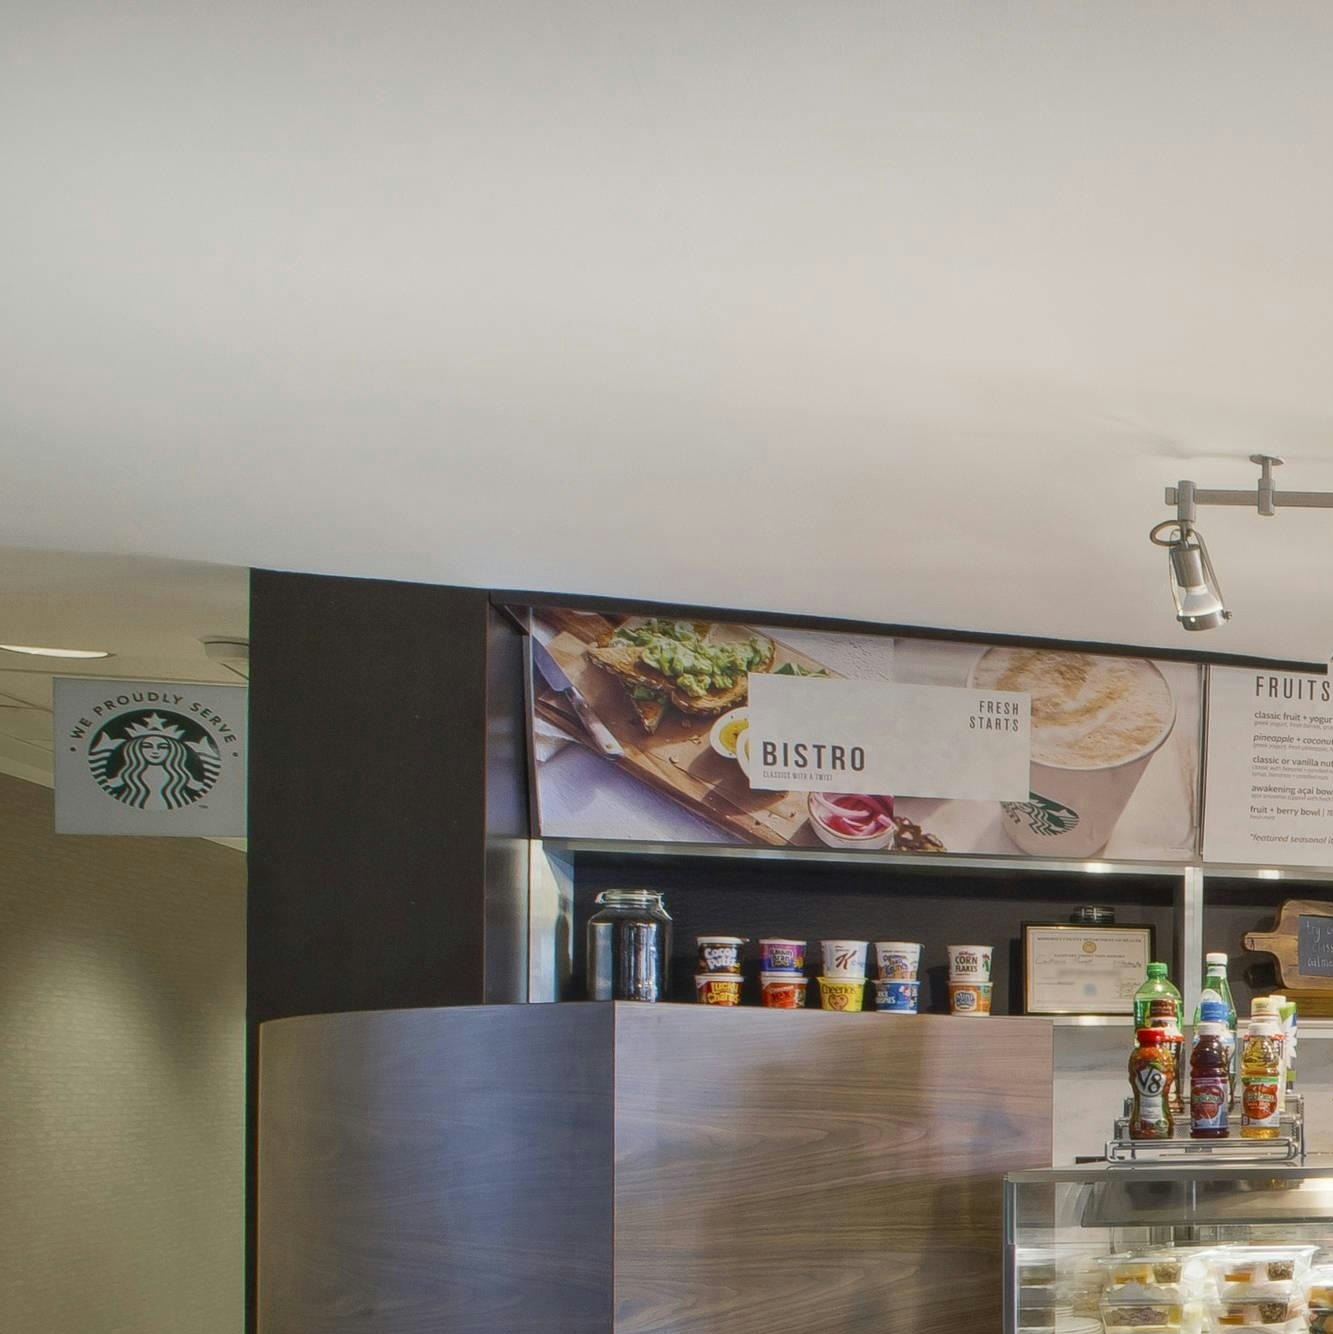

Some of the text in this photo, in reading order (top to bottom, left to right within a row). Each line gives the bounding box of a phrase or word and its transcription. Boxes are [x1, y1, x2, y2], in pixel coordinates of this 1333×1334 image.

[979, 700, 1019, 715] FRESH
[70, 691, 237, 743] WE PROUDLY SERVE
[1254, 710, 1281, 721] classic
[1283, 712, 1301, 721] fruit
[969, 716, 1020, 732] STARTS
[1253, 734, 1295, 744] pineapple
[762, 741, 865, 772] BISTRO
[1252, 755, 1280, 765] classic
[1291, 757, 1320, 767] vanilla
[1251, 784, 1295, 796] awakening
[1250, 805, 1268, 815] fruit
[1276, 807, 1299, 817] berry
[1300, 808, 1321, 817] bowl
[955, 956, 978, 965] CORN
[955, 964, 978, 973] FLAKES
[1135, 1067, 1162, 1094] V8
